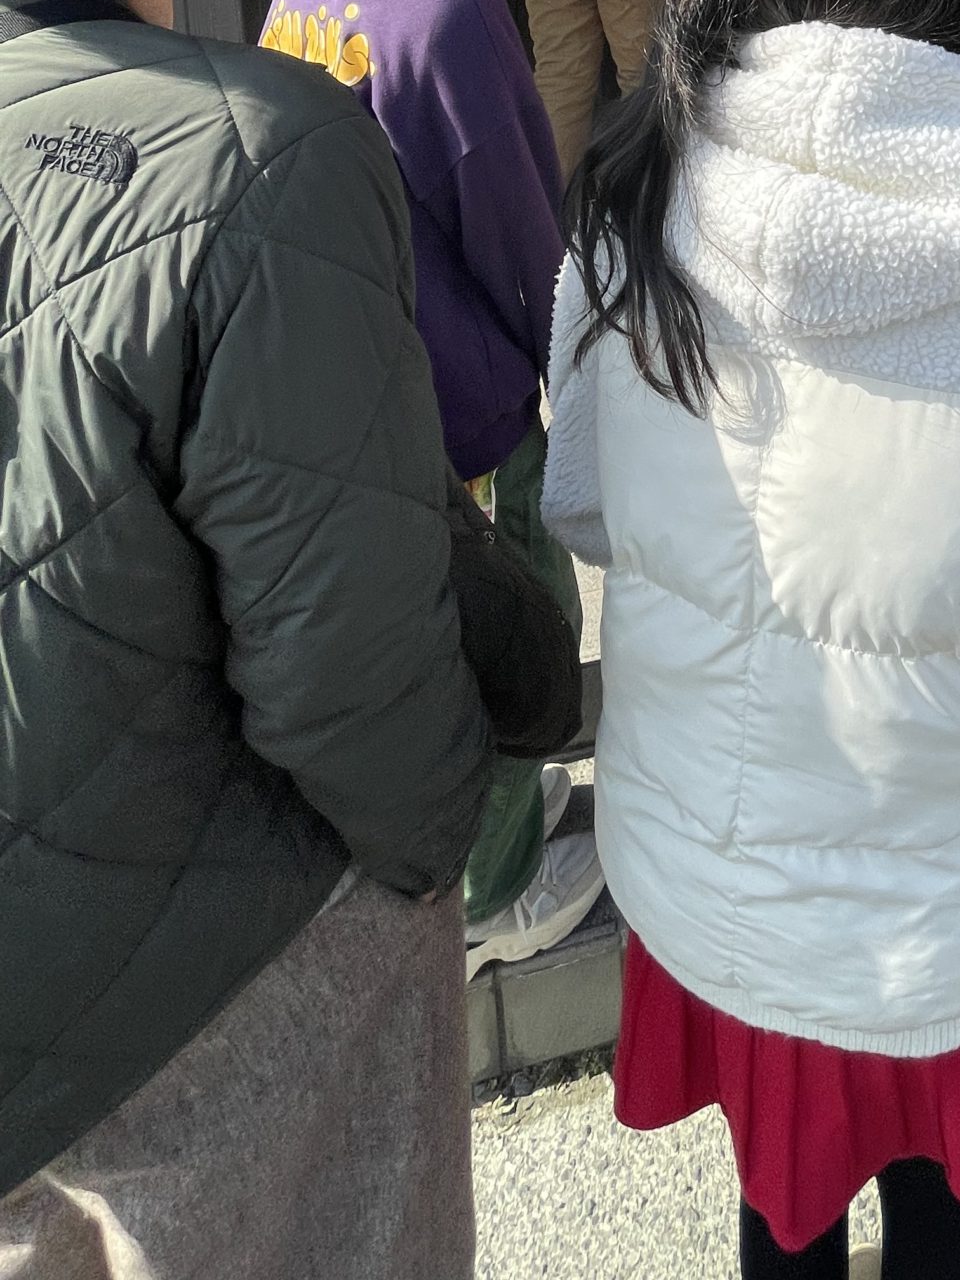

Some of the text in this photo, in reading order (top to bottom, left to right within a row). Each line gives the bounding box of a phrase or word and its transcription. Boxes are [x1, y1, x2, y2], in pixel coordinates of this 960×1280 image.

[25, 133, 106, 162] NORTH
[68, 124, 113, 147] THE
[37, 153, 99, 178] FACE
